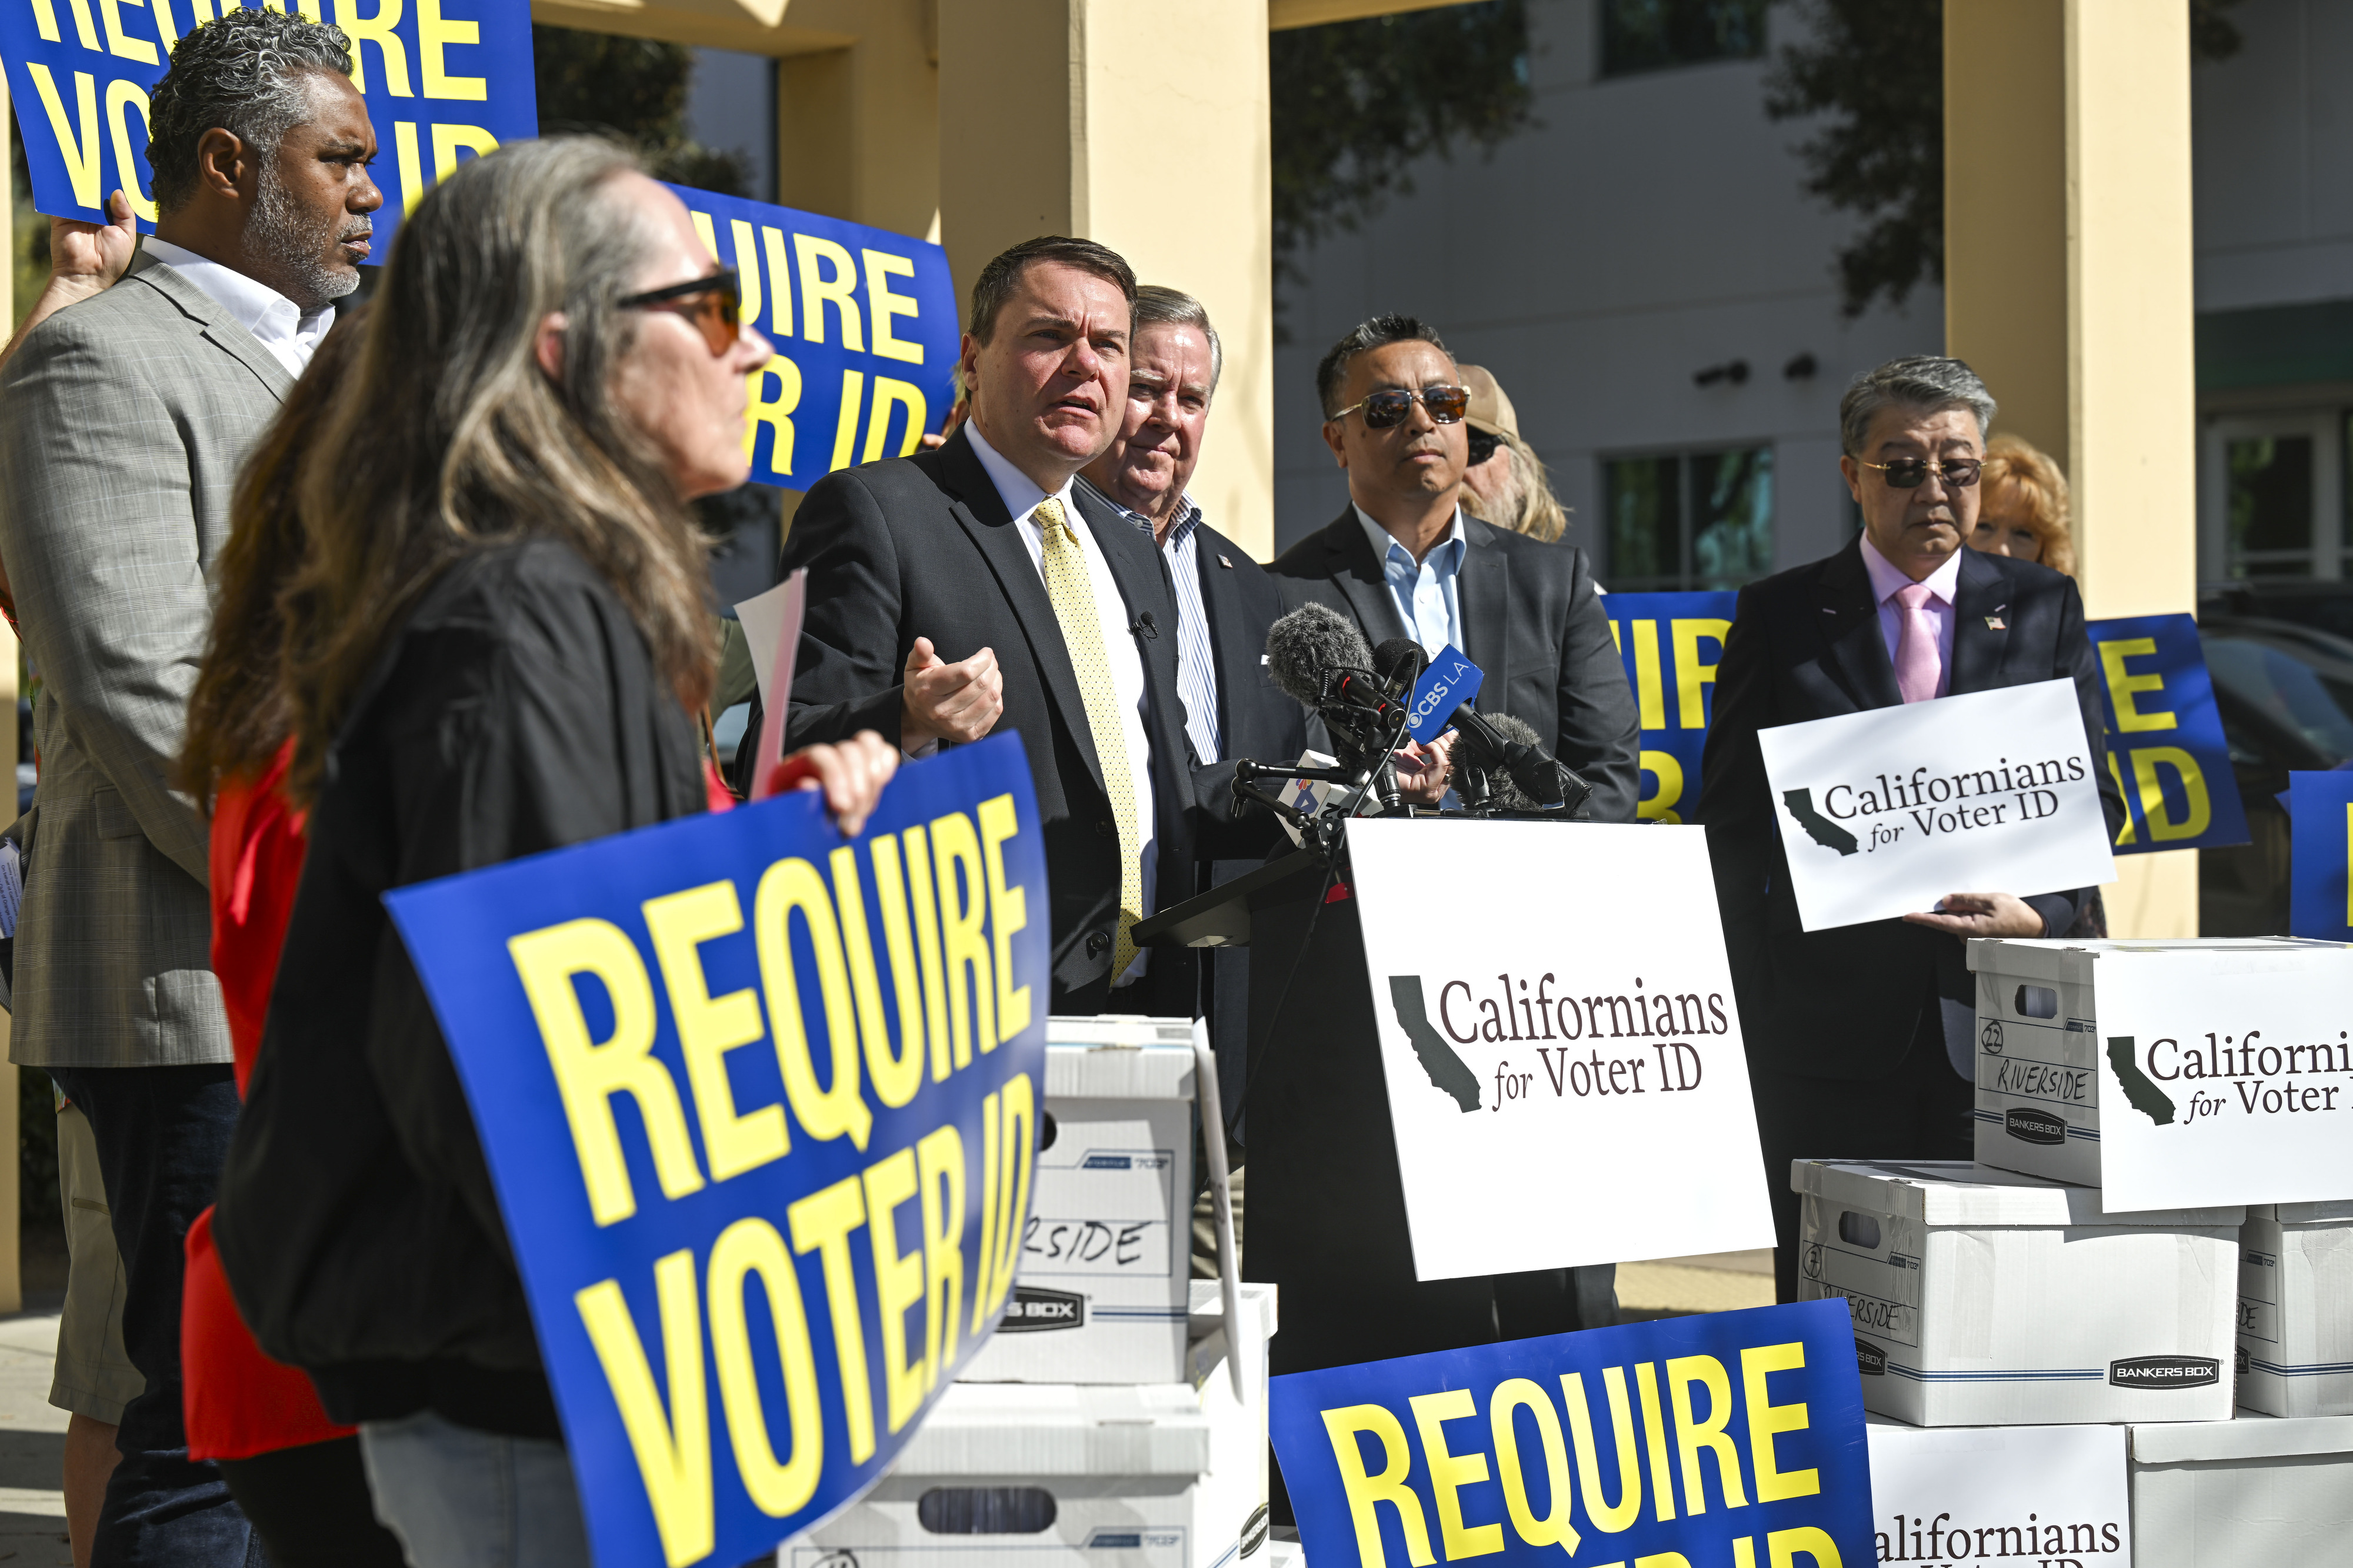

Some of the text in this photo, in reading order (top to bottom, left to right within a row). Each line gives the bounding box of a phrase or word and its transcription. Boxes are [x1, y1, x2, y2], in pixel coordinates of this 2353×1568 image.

[691, 210, 924, 365] UIRE
[829, 369, 927, 473] ID
[1418, 662, 1469, 716] CBS LA
[1825, 756, 2085, 819] Californians
[1868, 789, 2058, 852] for Voter ID
[508, 792, 1031, 1227] REQUIRE
[1440, 972, 1728, 1044] Californians
[1985, 1027, 2002, 1047] 22
[2148, 1030, 2353, 1080] Californi
[1492, 1043, 1702, 1112] for Voter ID
[1998, 1059, 2089, 1100] RIVERSIDE
[2183, 1090, 2227, 1125] for
[2233, 1080, 2339, 1114] Voter
[2009, 1117, 2062, 1136] BANKERS BOX
[1025, 1216, 1153, 1265] RSIDE
[575, 1073, 1034, 1568] VOTER ID
[1026, 1302, 1076, 1318] BOX
[1865, 1355, 1882, 1367] BOX
[2117, 1366, 2214, 1378] BANKERS BOX
[1321, 1342, 1821, 1568] REQUIRE
[1875, 1513, 2121, 1562] alifornians
